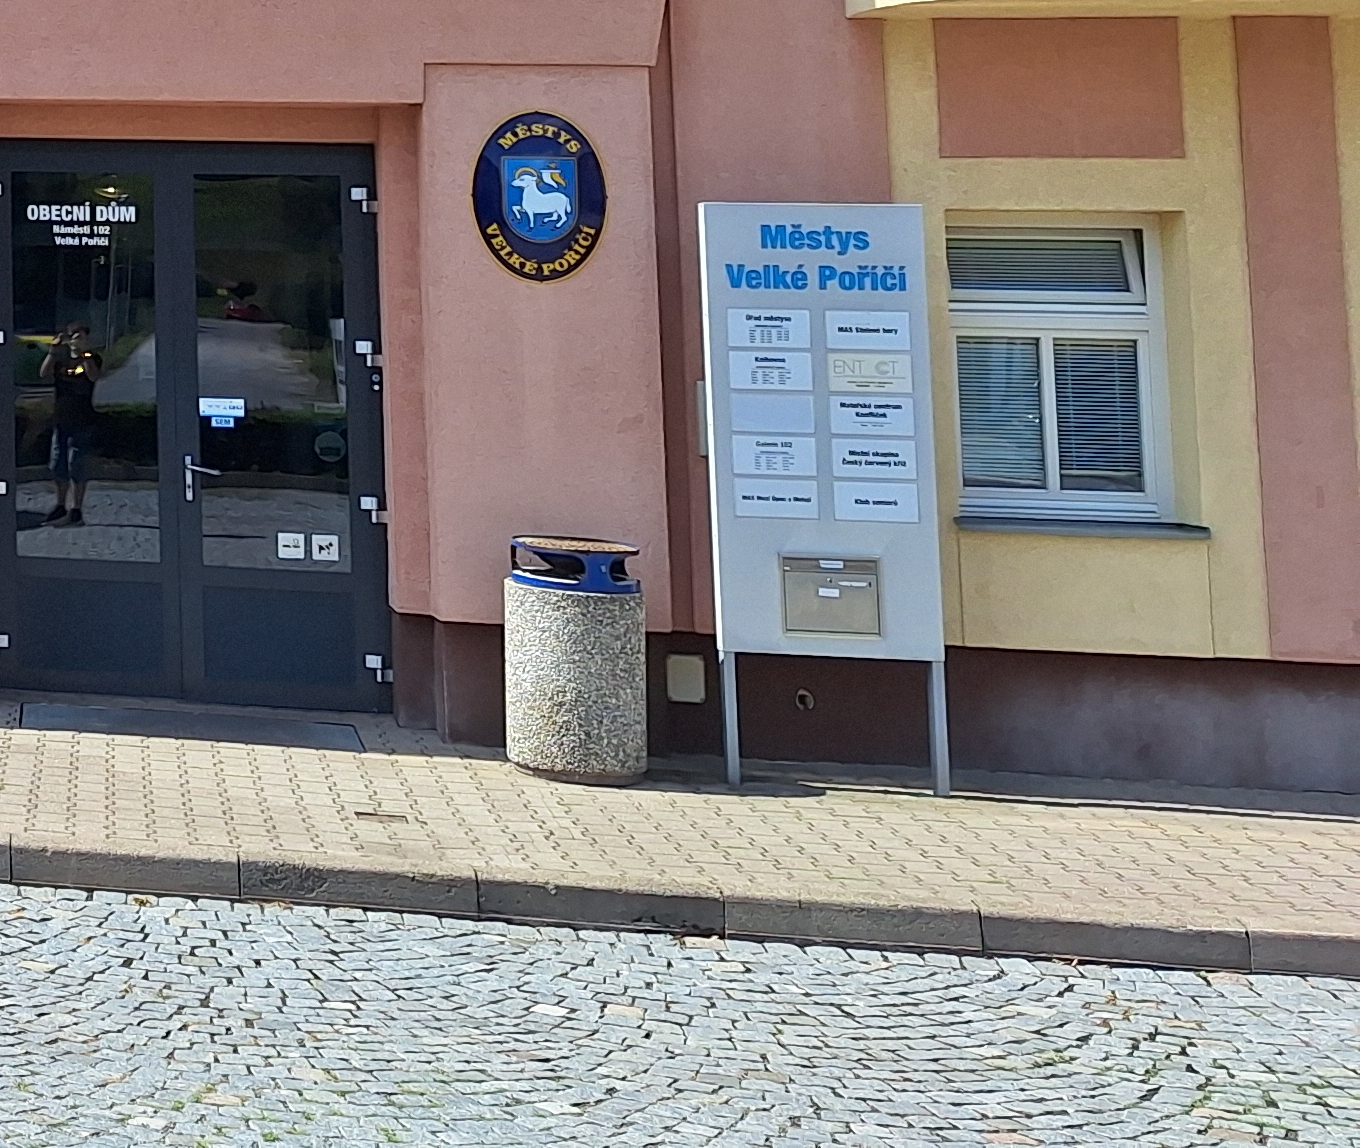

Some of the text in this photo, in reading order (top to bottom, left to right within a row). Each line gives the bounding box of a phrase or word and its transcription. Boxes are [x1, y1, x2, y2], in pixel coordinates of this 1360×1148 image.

[497, 123, 581, 153] MĚSTYS
[27, 201, 136, 222] OBECNÍ DŮM
[93, 225, 111, 234] 102
[760, 223, 870, 255] Městys
[485, 223, 597, 276] VELKÉ POŘÍČÍ
[725, 263, 907, 292] Velké Poříčí
